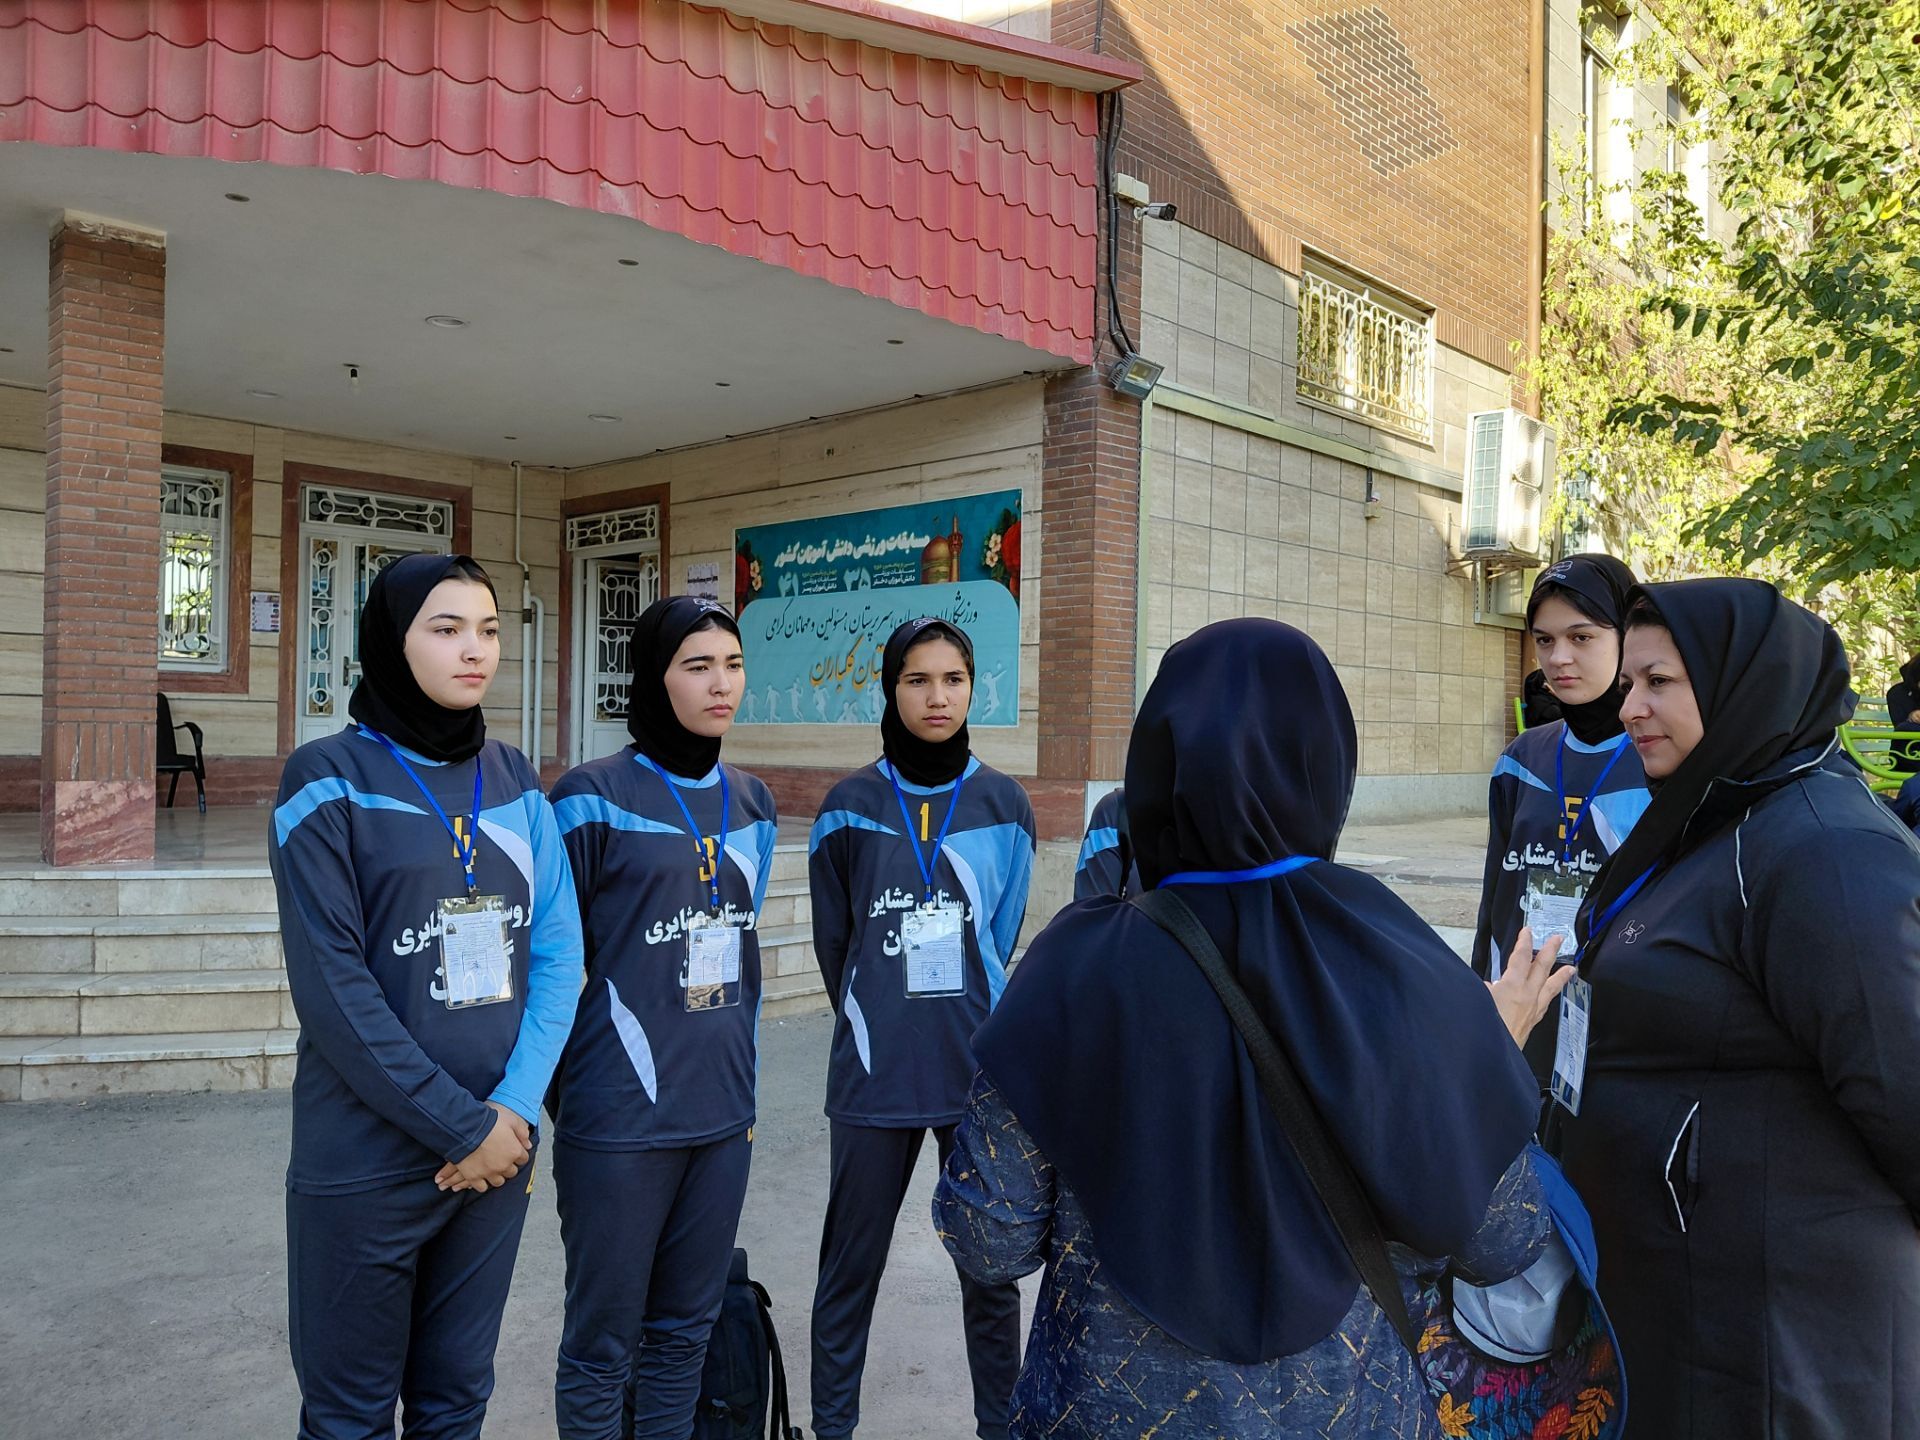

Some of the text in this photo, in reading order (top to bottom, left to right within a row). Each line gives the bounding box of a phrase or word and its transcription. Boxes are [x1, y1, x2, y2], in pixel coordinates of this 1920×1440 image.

[826, 538, 853, 563] دانش
[852, 534, 886, 560] ورزشی
[886, 531, 931, 554] مسابقات
[919, 802, 929, 841] 1
[1559, 797, 1583, 841] 5
[695, 837, 718, 881] 3
[868, 887, 914, 918] عشایر
